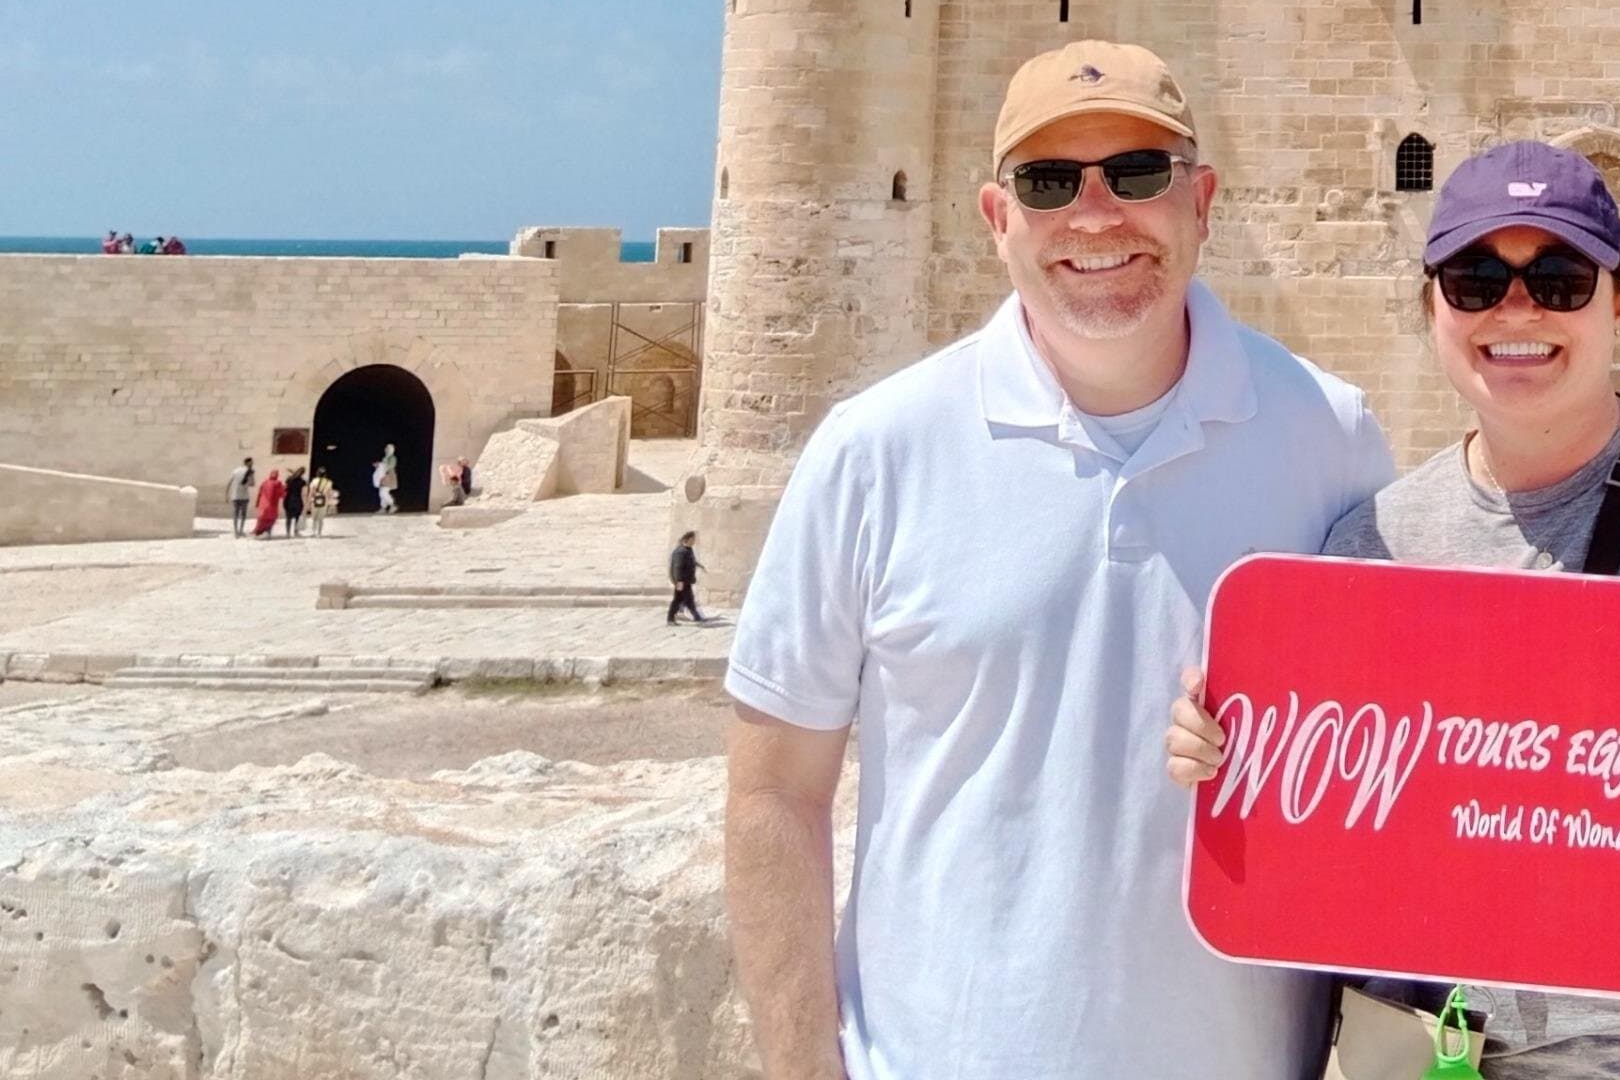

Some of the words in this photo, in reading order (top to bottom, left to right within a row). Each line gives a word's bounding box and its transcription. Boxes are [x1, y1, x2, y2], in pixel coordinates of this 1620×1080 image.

[1211, 691, 1433, 831] WOW
[1436, 716, 1560, 771] TOURS
[1452, 799, 1524, 841] World
[1530, 806, 1560, 844] Of
